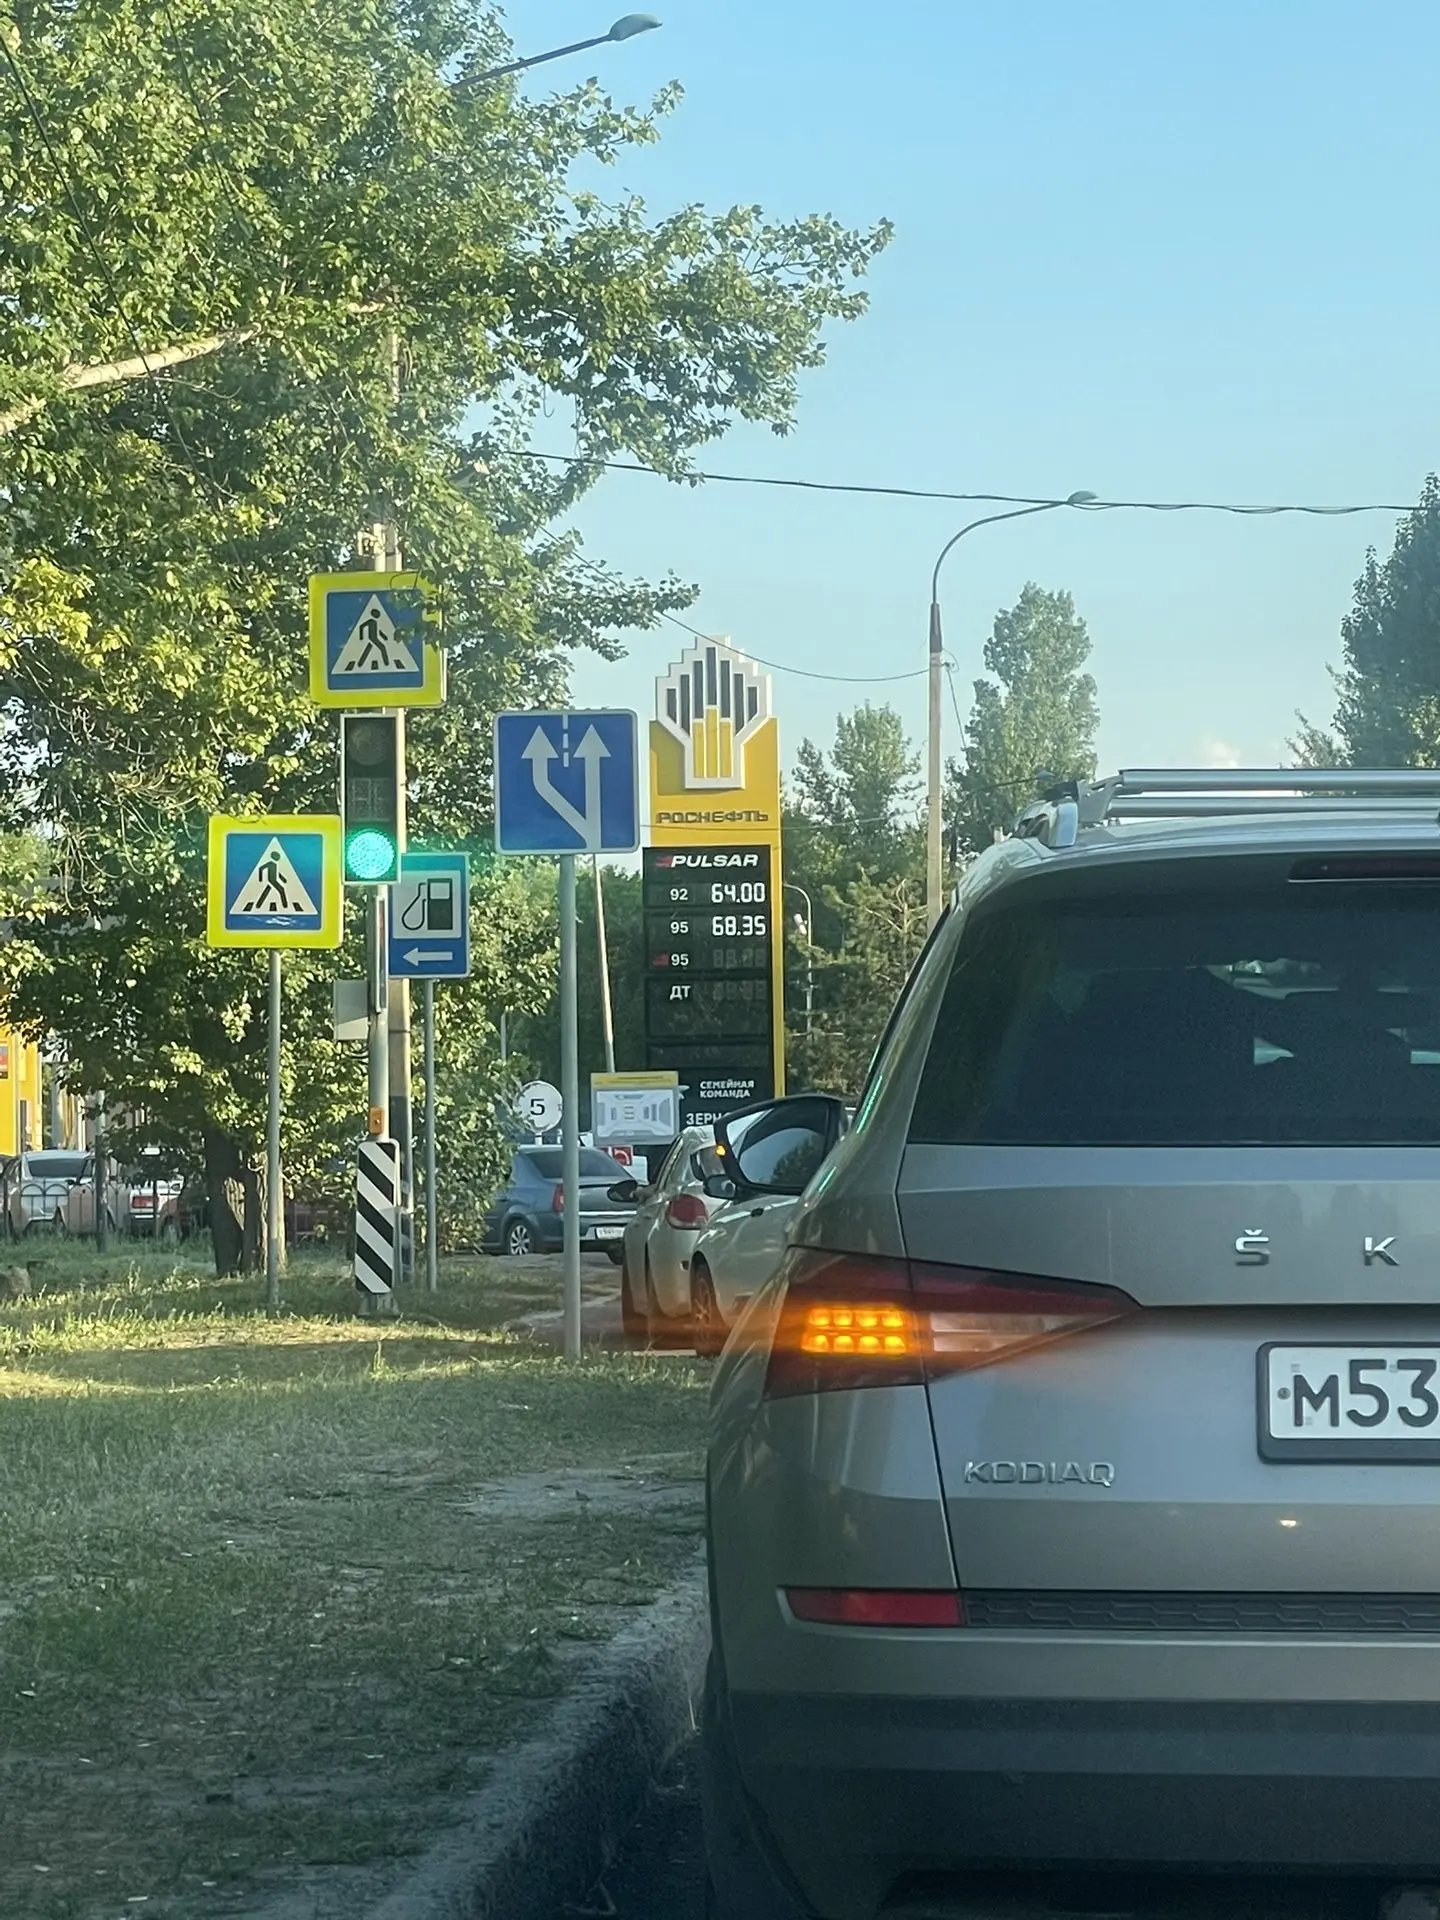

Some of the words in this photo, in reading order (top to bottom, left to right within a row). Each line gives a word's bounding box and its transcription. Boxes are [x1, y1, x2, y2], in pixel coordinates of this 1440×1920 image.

[655, 810, 769, 824] РОСНЕФТЬ
[670, 854, 759, 868] PULSAR
[670, 888, 689, 901] 92
[711, 882, 766, 903] 64.00
[670, 921, 689, 934] 95
[712, 915, 766, 936] 68.35
[671, 953, 689, 966] 95
[669, 985, 691, 1001] ДТ
[700, 1079, 755, 1090] СЕМЕЙНАЯ
[700, 1089, 751, 1099] КОМАНДА
[530, 1098, 545, 1116] 5
[686, 1112, 731, 1125] ЗЕРН
[964, 1460, 1115, 1488] KODIAQ
